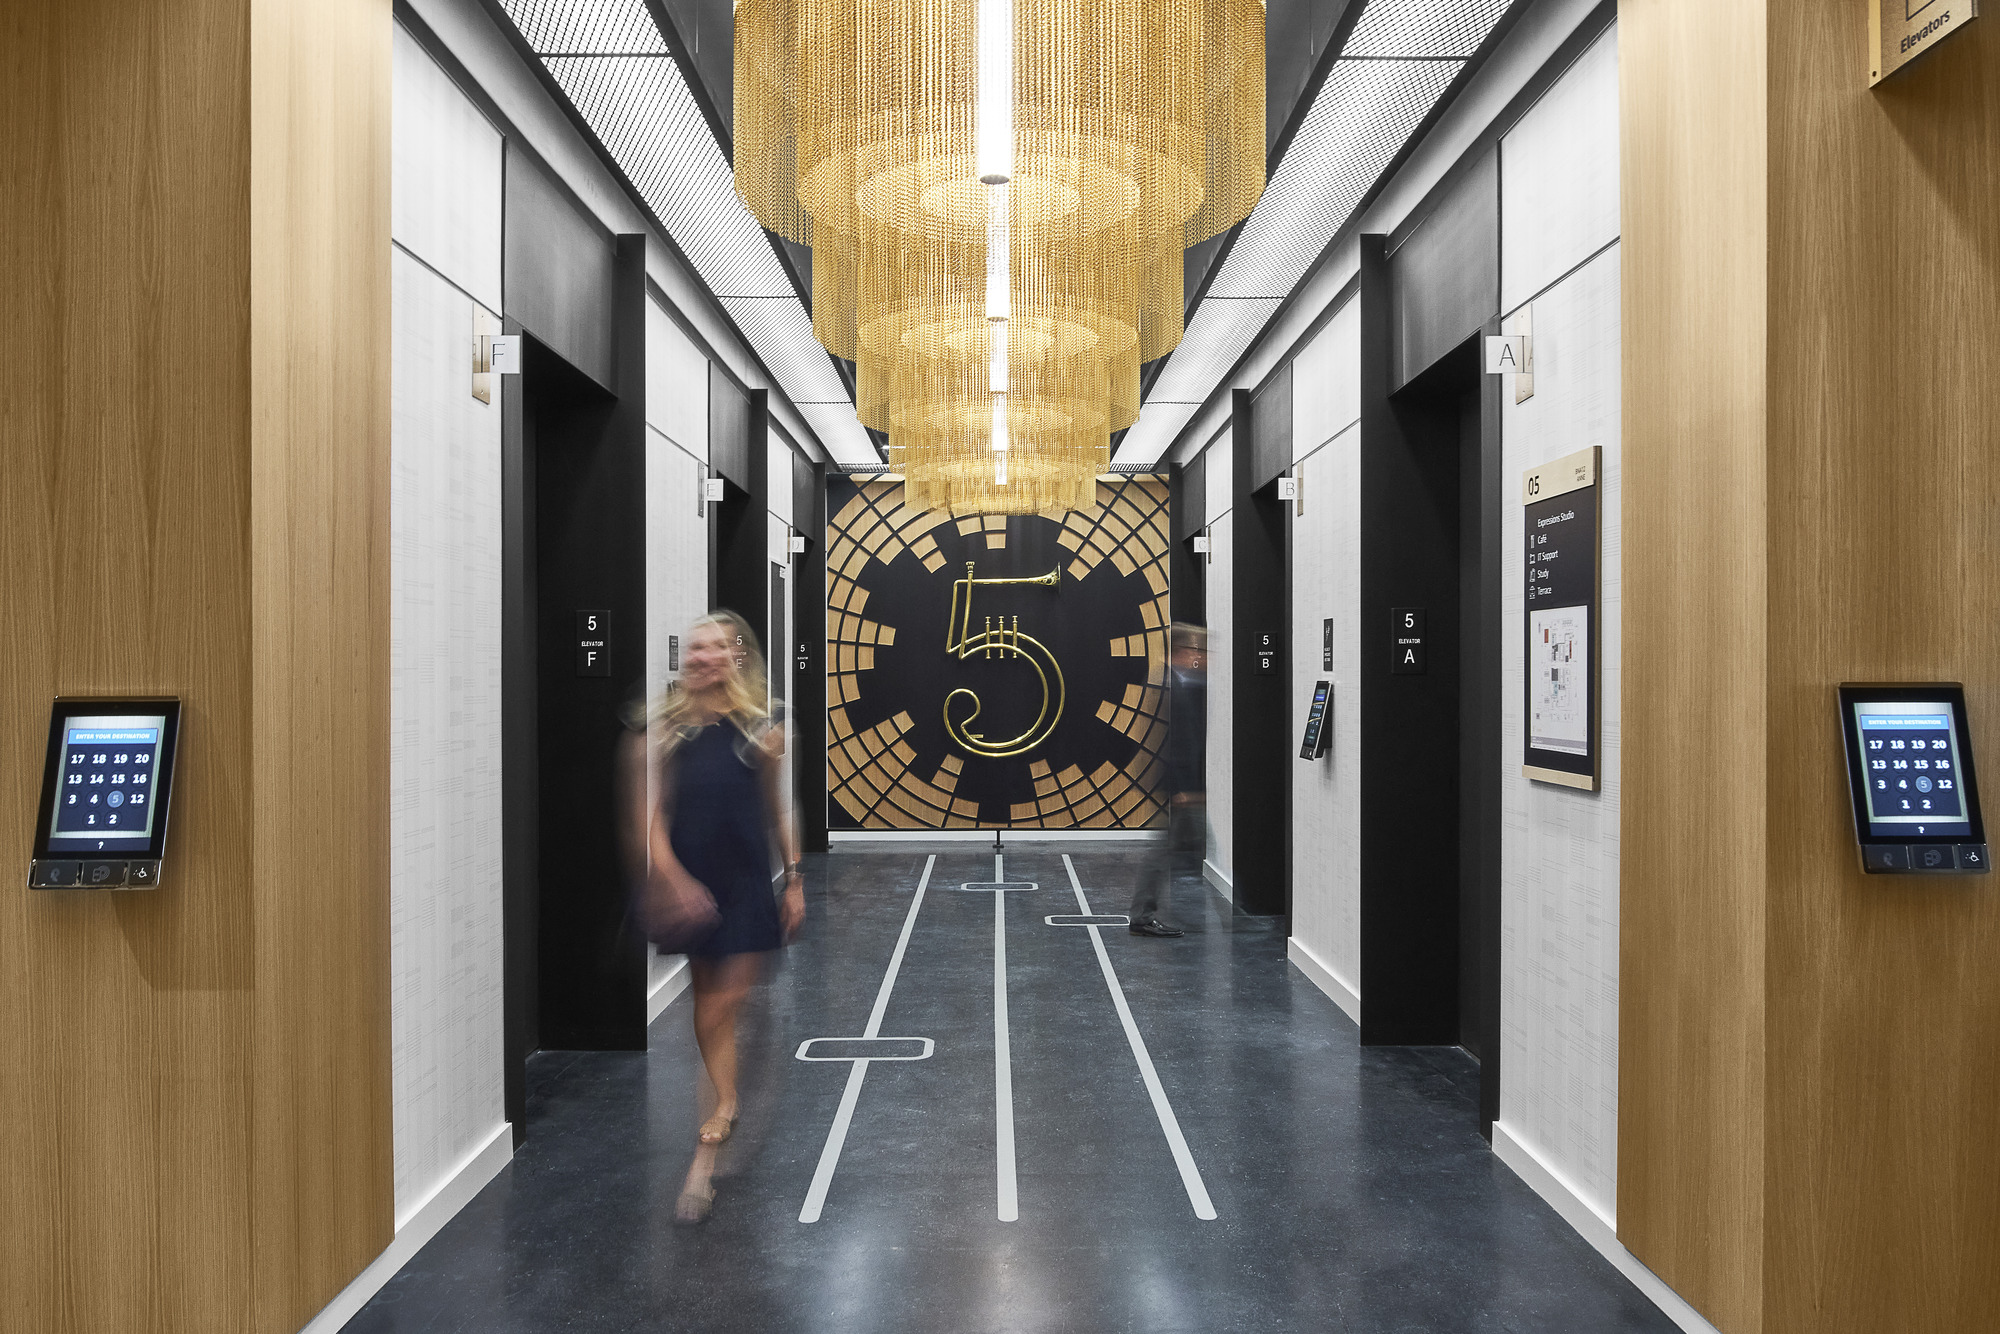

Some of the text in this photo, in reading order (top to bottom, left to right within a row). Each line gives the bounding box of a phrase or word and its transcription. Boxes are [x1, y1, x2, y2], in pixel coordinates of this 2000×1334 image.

[1900, 10, 1950, 53] Elevators
[492, 343, 505, 366] F
[1499, 344, 1515, 366] A
[706, 483, 715, 497] E
[1286, 482, 1295, 496] B
[1528, 475, 1539, 495] 05
[1538, 510, 1575, 528] Expressions Studio
[1538, 534, 1547, 544] Café
[1542, 550, 1559, 561] Support
[1537, 569, 1549, 579] Study
[1537, 586, 1552, 595] Terrace
[588, 616, 597, 630] 5
[1405, 613, 1414, 628] 5
[736, 635, 743, 645] 5
[1262, 635, 1269, 645] 5
[800, 644, 805, 652] 5
[588, 652, 597, 666] F
[943, 561, 1065, 757] 5
[1404, 649, 1415, 664] A
[736, 658, 742, 668] E
[800, 661, 806, 670] D
[1192, 660, 1199, 668] C
[1262, 658, 1269, 668] B
[1869, 740, 1947, 750] 17 18 19 20
[71, 753, 150, 764] 17 18 19 20
[1872, 760, 1950, 769] 13 14 15 16
[68, 774, 147, 784] 13 14 15 16
[1877, 780, 1952, 789] 3 4 5 12
[68, 794, 145, 804] 3 4 5 12
[1901, 800, 1931, 809] 1 2
[88, 814, 117, 824] 1 2
